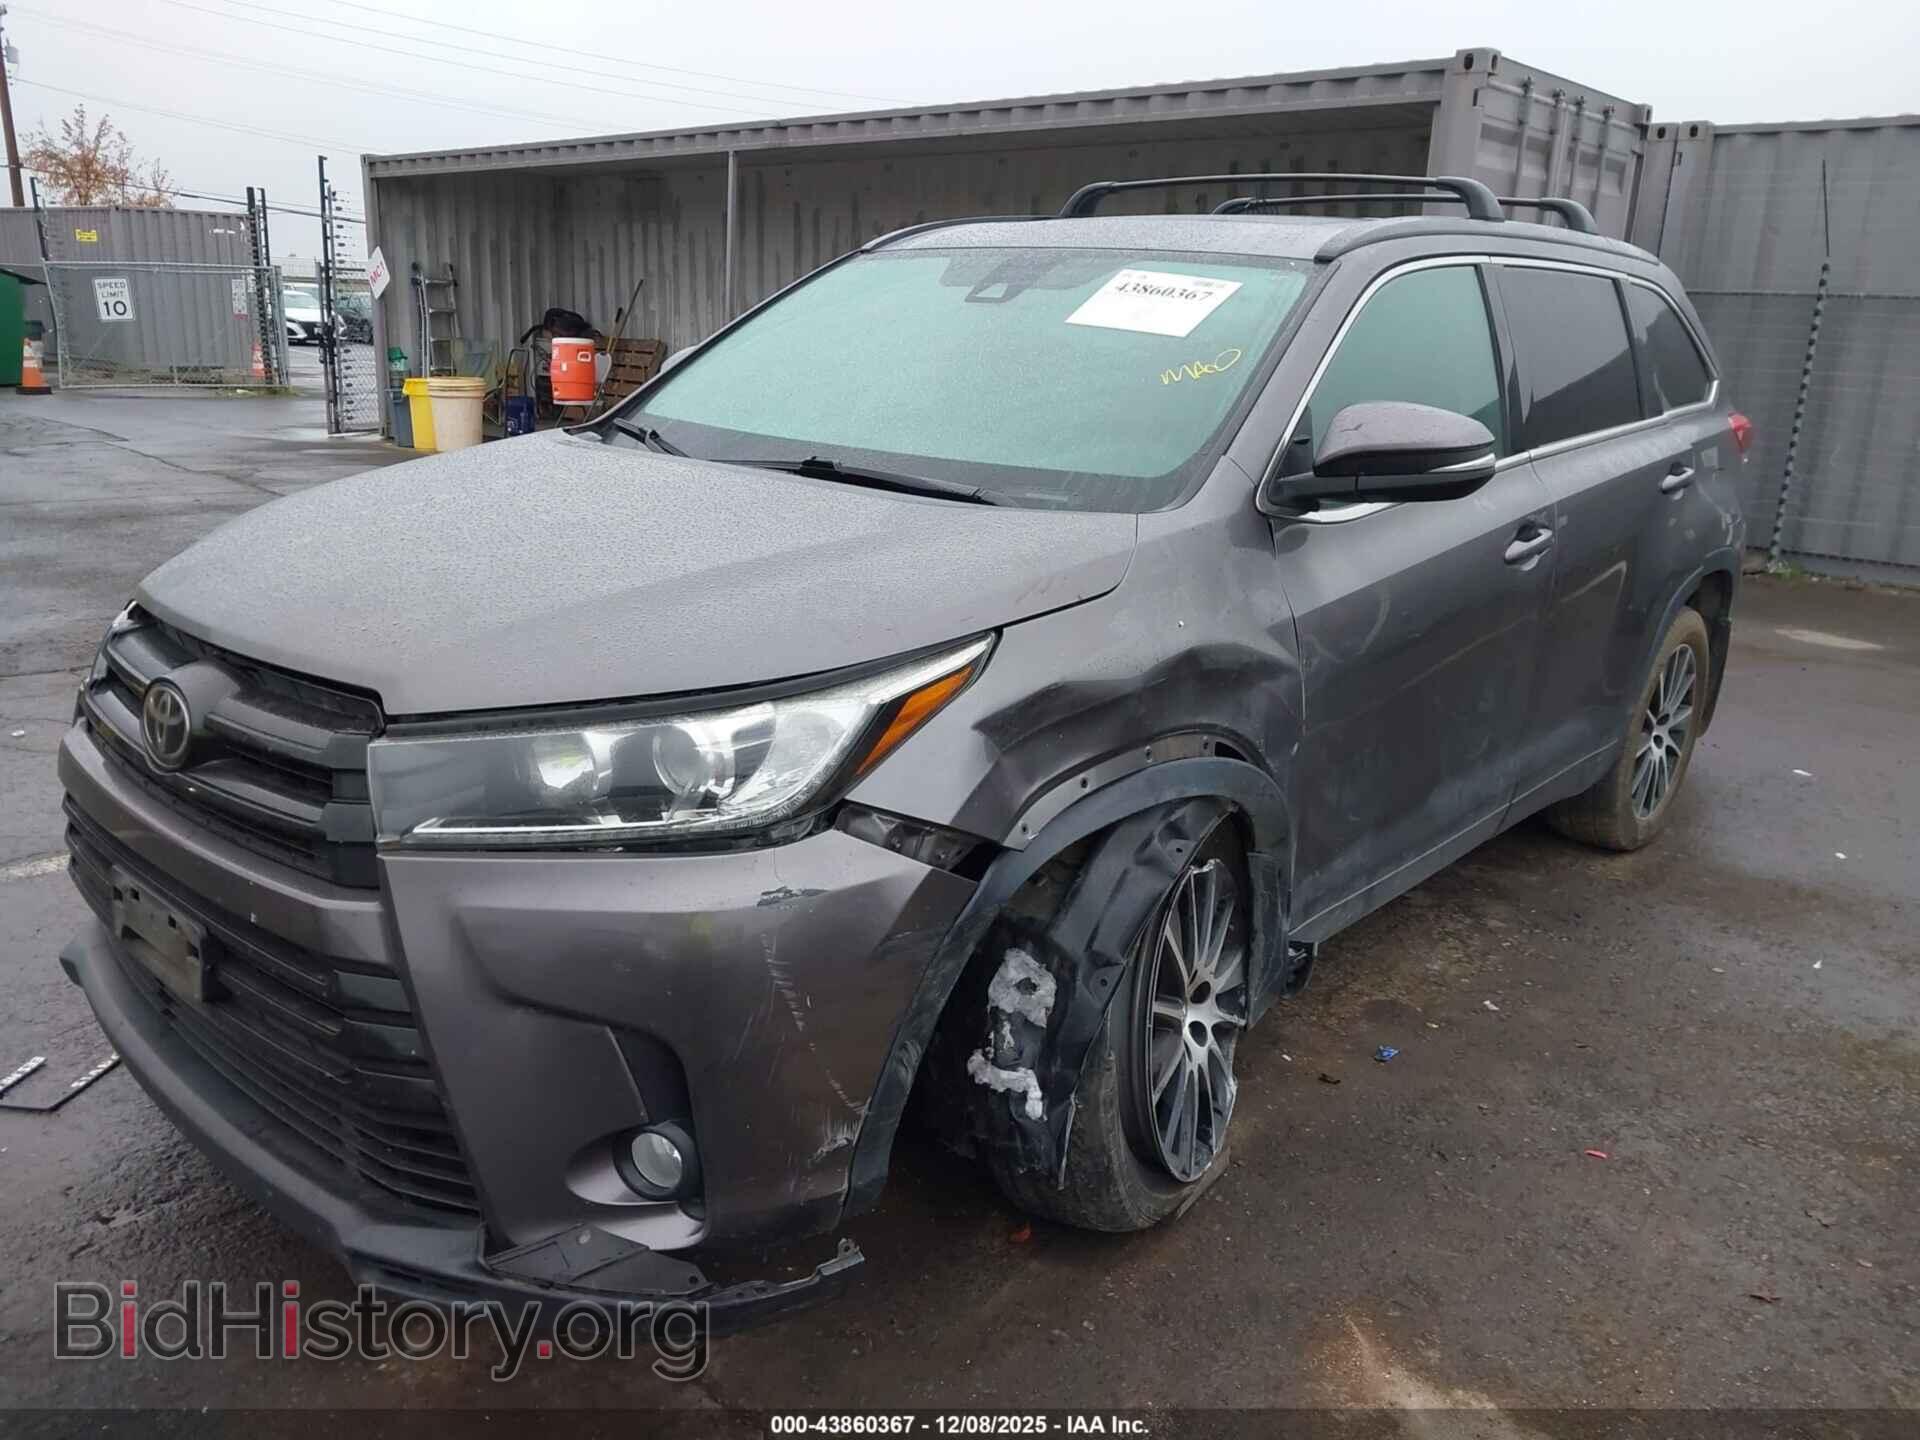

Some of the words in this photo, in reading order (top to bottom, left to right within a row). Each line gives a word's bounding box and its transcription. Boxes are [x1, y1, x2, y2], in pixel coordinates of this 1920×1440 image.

[101, 290, 124, 298] LIMIT
[1116, 281, 1214, 301] 43860367
[103, 300, 127, 316] 10
